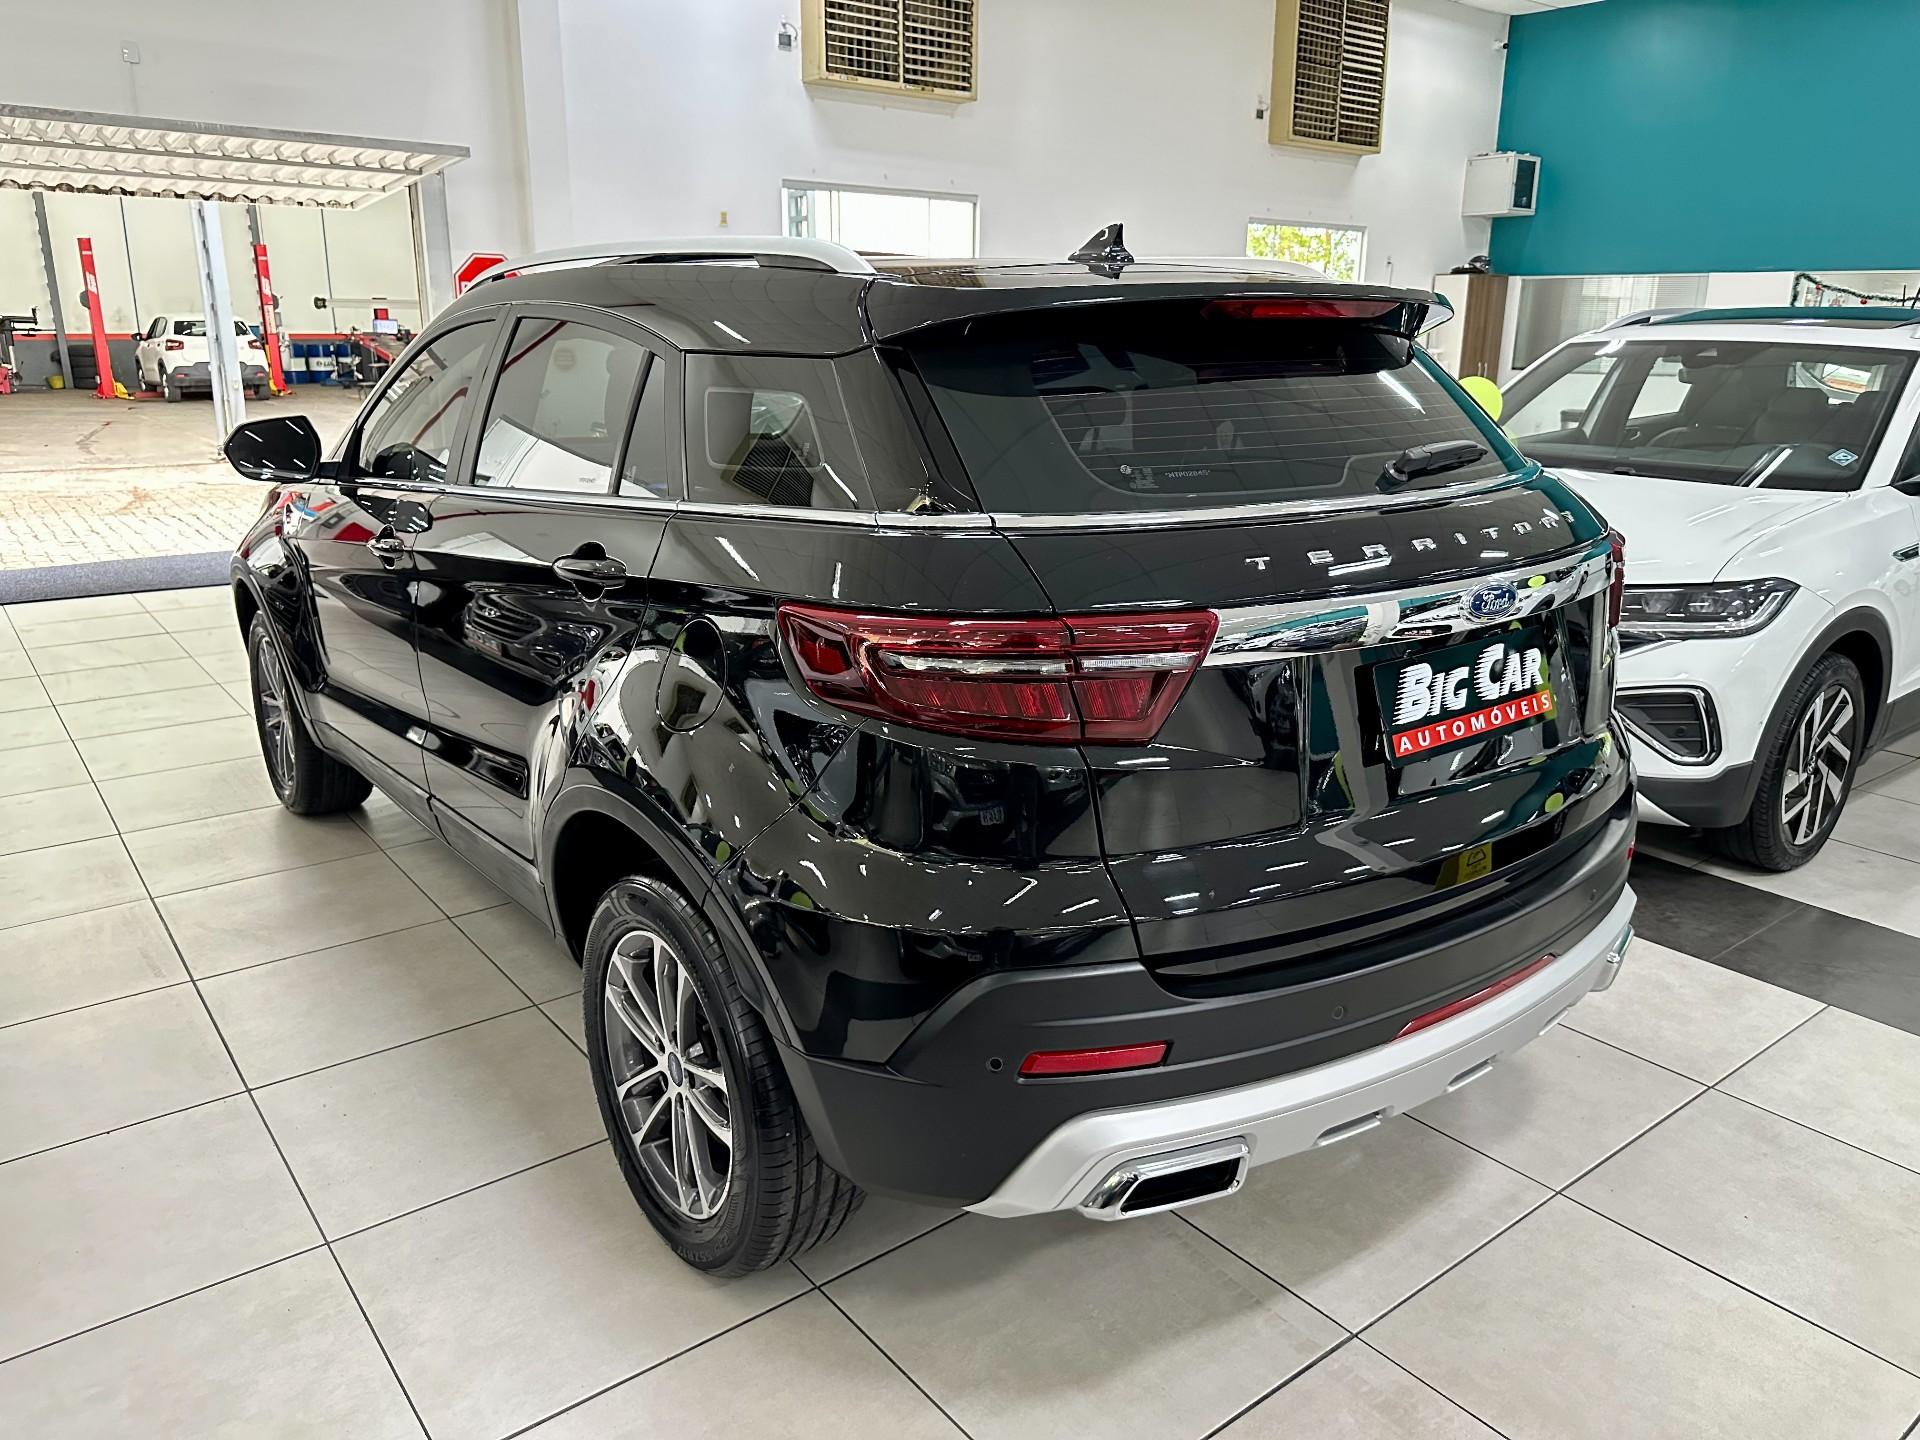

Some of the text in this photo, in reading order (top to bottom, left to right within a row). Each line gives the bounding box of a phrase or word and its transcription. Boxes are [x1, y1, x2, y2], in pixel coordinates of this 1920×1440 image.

[1480, 589, 1510, 612] Ford
[1392, 643, 1544, 726] BIG CAR
[1400, 694, 1551, 753] AUTOMÓVEIS
